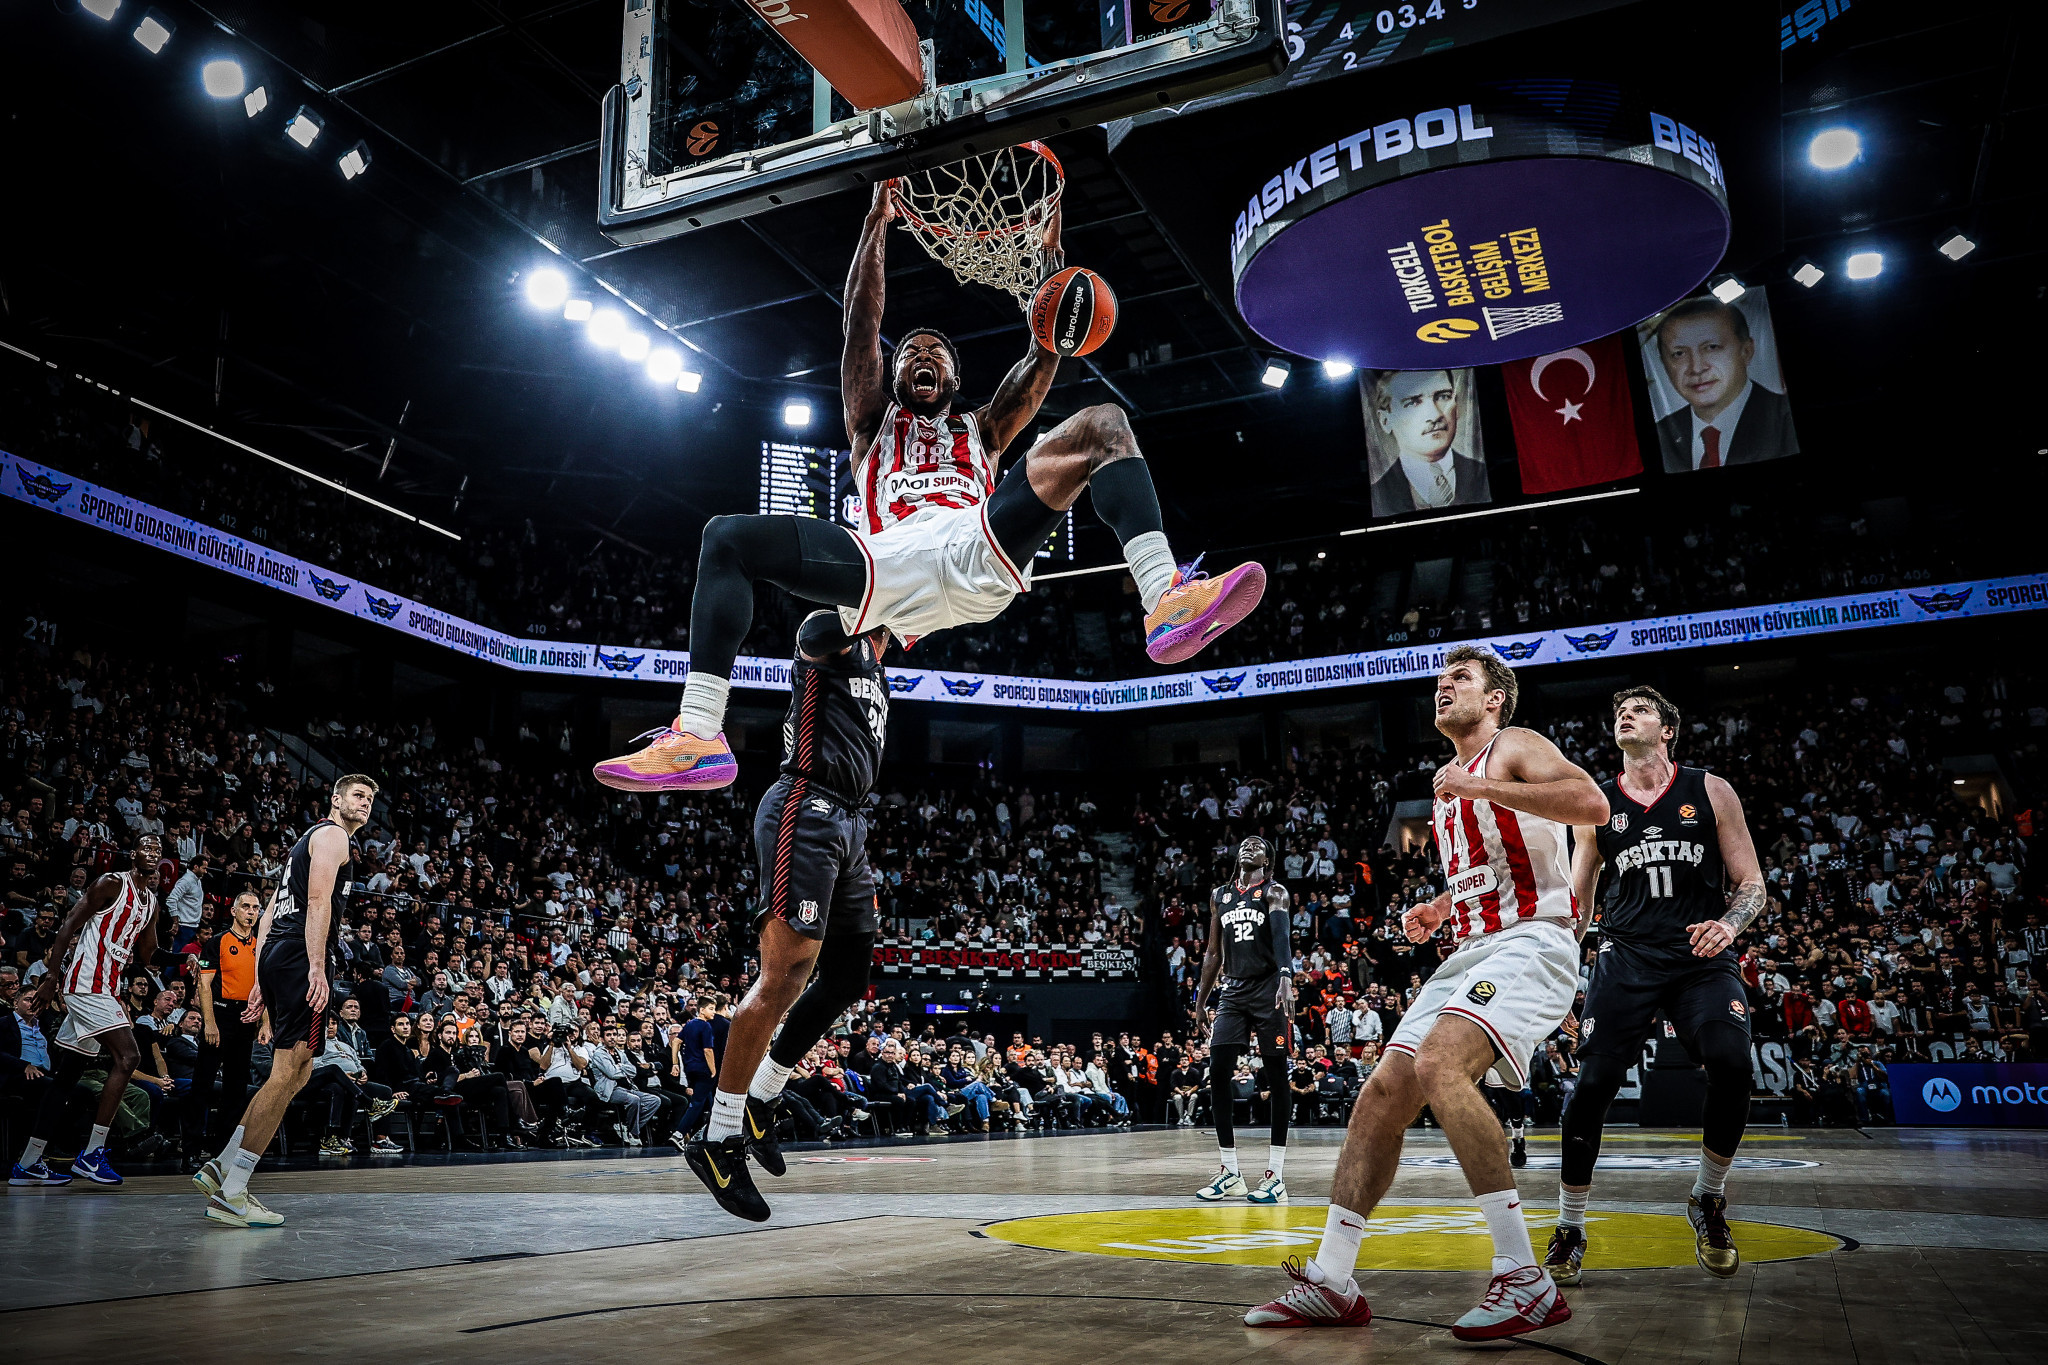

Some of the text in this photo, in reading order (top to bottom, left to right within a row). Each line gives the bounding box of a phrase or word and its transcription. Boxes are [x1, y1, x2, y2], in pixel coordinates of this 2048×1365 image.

[1340, 22, 1355, 40] 4
[1343, 52, 1358, 71] 2
[1233, 104, 1494, 254] BASKETBOL
[1387, 241, 1438, 314] TURKCELL
[1421, 218, 1475, 307] BASKETBOL
[1469, 240, 1513, 300] GELİŞİM
[1502, 226, 1552, 294] MERKEZİ
[1037, 280, 1062, 343] SPALDING
[1065, 286, 1085, 338] EuroLeague
[910, 440, 945, 466] 88
[933, 476, 971, 490] SUPER
[79, 492, 299, 588] SPORCU GIDASININ GÜVENİLİR ADRESİ!
[408, 610, 587, 669] SPORCU GIDASININ GÜVENİLİR ADRESİ!
[526, 622, 547, 635] 410
[1427, 626, 1443, 639] 07
[1631, 625, 1687, 648] SPORCU
[1690, 615, 1760, 640] GIDASININ
[1763, 604, 1838, 632] GÜVENİLİR
[1841, 597, 1901, 622] ADRESİ!
[653, 658, 691, 677] SPORC
[1256, 667, 1303, 689] SPORCU
[1304, 660, 1365, 684] GIDASININ
[1367, 653, 1429, 677] GÜVENİLİR
[993, 683, 1036, 700] SPORCU
[1037, 685, 1091, 706] GIDASININ
[1092, 683, 1149, 706] GÜVENİLİR
[1150, 678, 1194, 700] ADRESİ!
[1443, 824, 1463, 862] 14
[1457, 872, 1487, 894] SUPER
[1645, 865, 1674, 899] 11
[1232, 921, 1255, 943] 32
[872, 946, 1082, 972] ŞEY BEŞİKTAŞ İÇİN!
